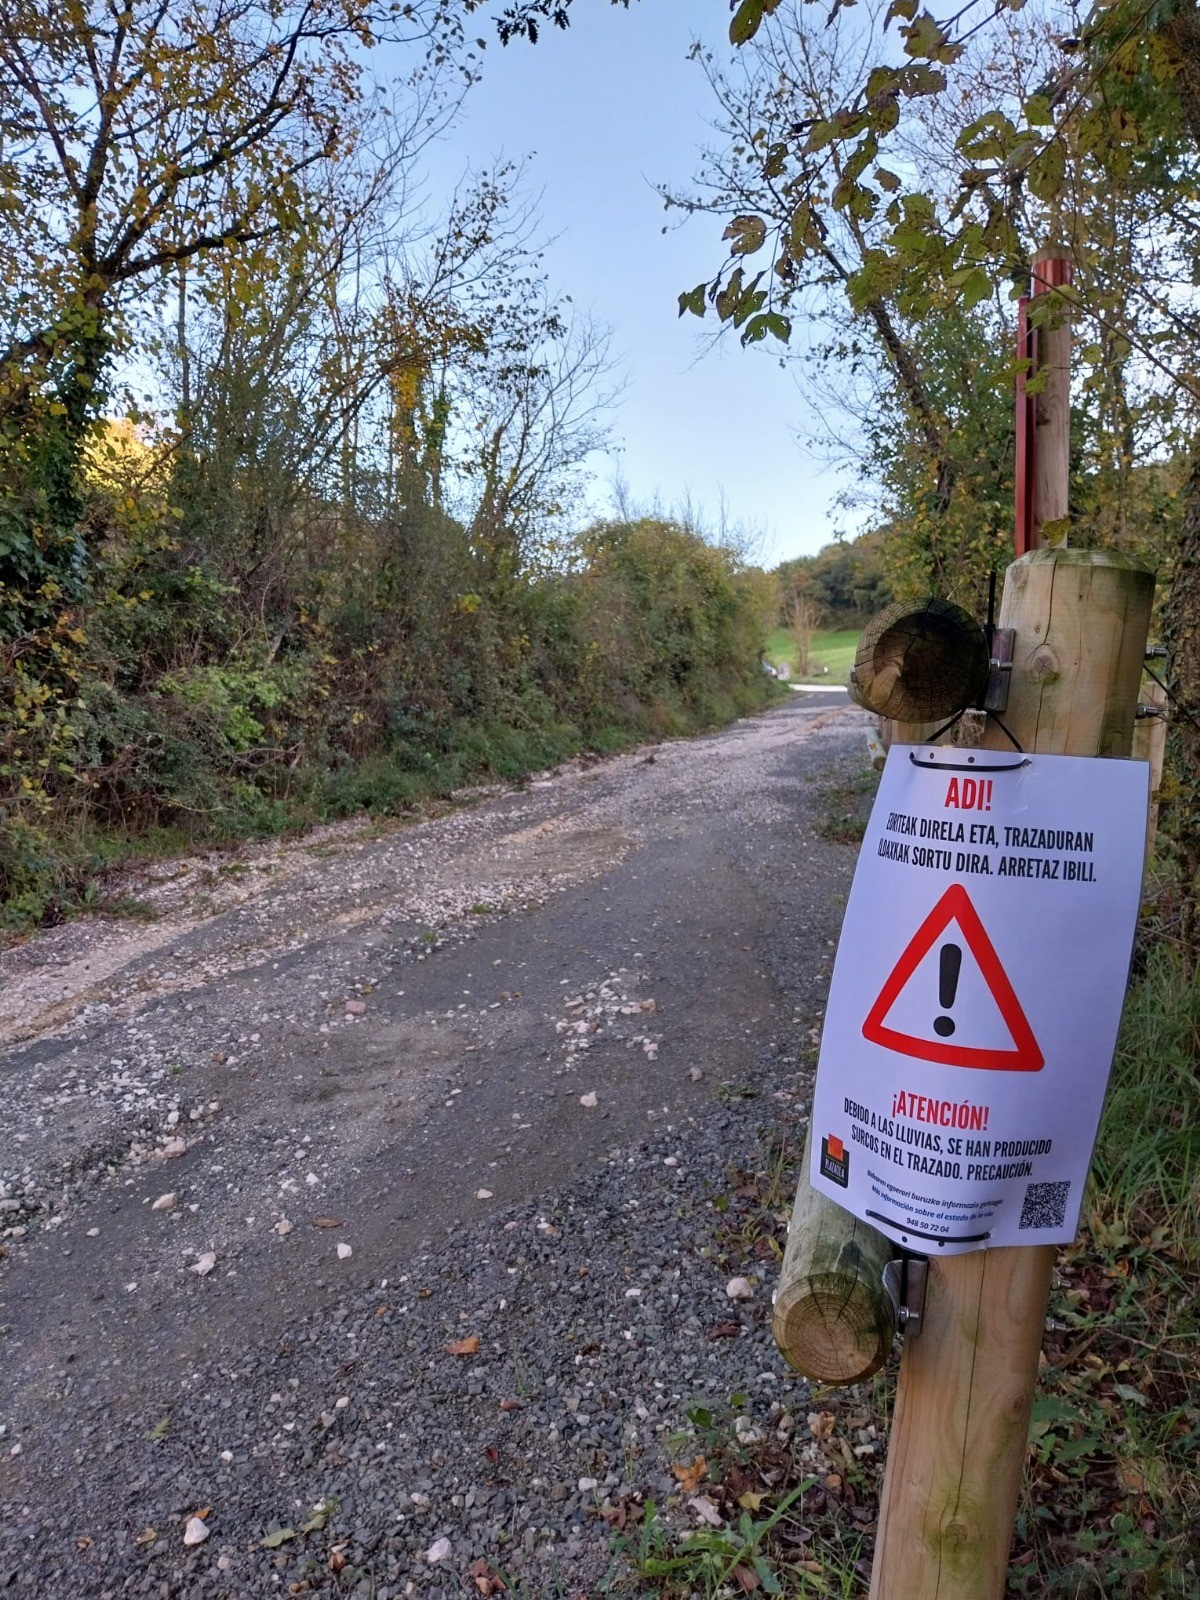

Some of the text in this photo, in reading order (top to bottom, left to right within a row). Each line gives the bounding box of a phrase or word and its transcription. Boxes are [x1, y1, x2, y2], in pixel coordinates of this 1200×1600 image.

[944, 778, 993, 811] ADI!
[886, 813, 1093, 852] EURITEAK DIRELA ETA, TRAZADURAN
[912, 847, 951, 870] SORTU
[957, 853, 993, 875] DIRA.
[998, 857, 1058, 880] ARRETAZ
[1063, 861, 1096, 882] IBILI.
[844, 1097, 1052, 1157] DEBIDO A LAS LLUVIAS, SE HAN PRODUCIDO
[892, 1091, 989, 1131] ¡ATENCIÓN!
[851, 1125, 1033, 1181] SURCOS EN EL TRAZADO. PRECAUCIÓN.
[881, 1190, 913, 1212] información
[915, 1207, 934, 1218] sobre
[887, 1183, 910, 1197] egoerari
[912, 1193, 940, 1205] buruzko
[942, 1200, 979, 1209] informazio
[906, 1217, 950, 1233] 948 50 72 04
